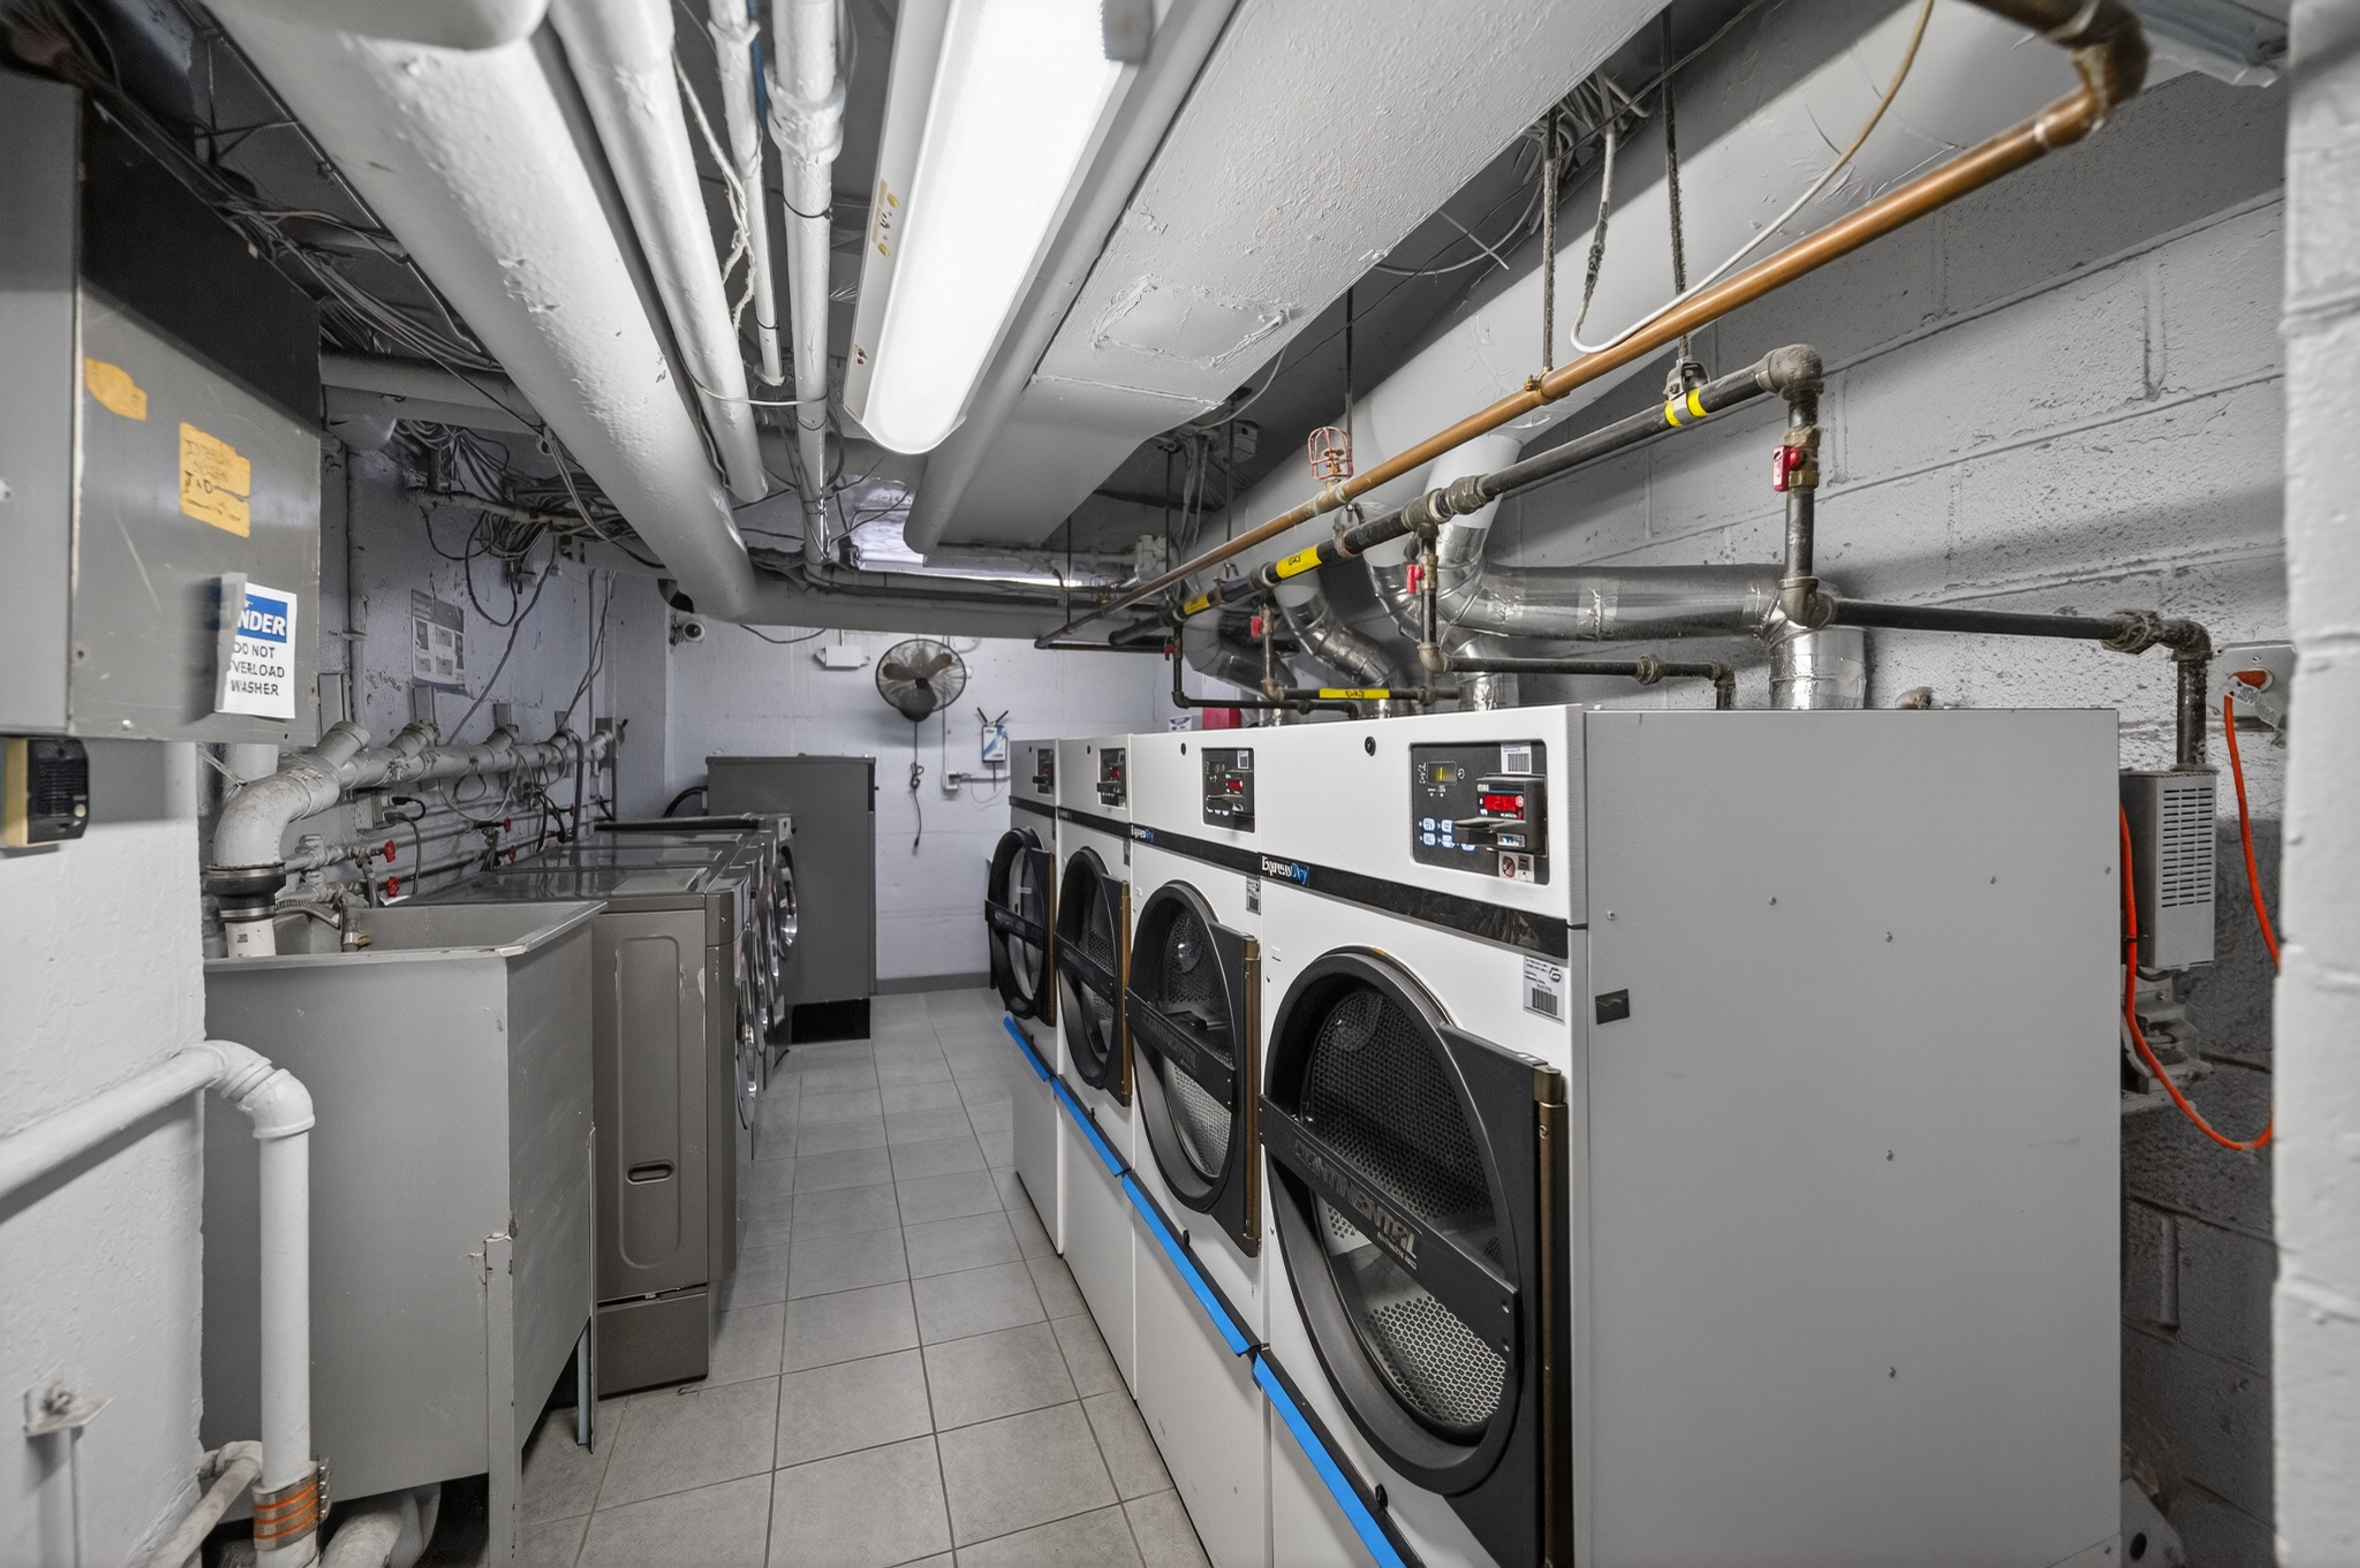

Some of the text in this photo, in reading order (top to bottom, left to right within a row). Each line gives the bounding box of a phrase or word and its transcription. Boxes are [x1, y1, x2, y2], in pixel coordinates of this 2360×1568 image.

[237, 609, 286, 637] NDER
[234, 641, 275, 658] DO NOT
[231, 679, 279, 696] WASHER
